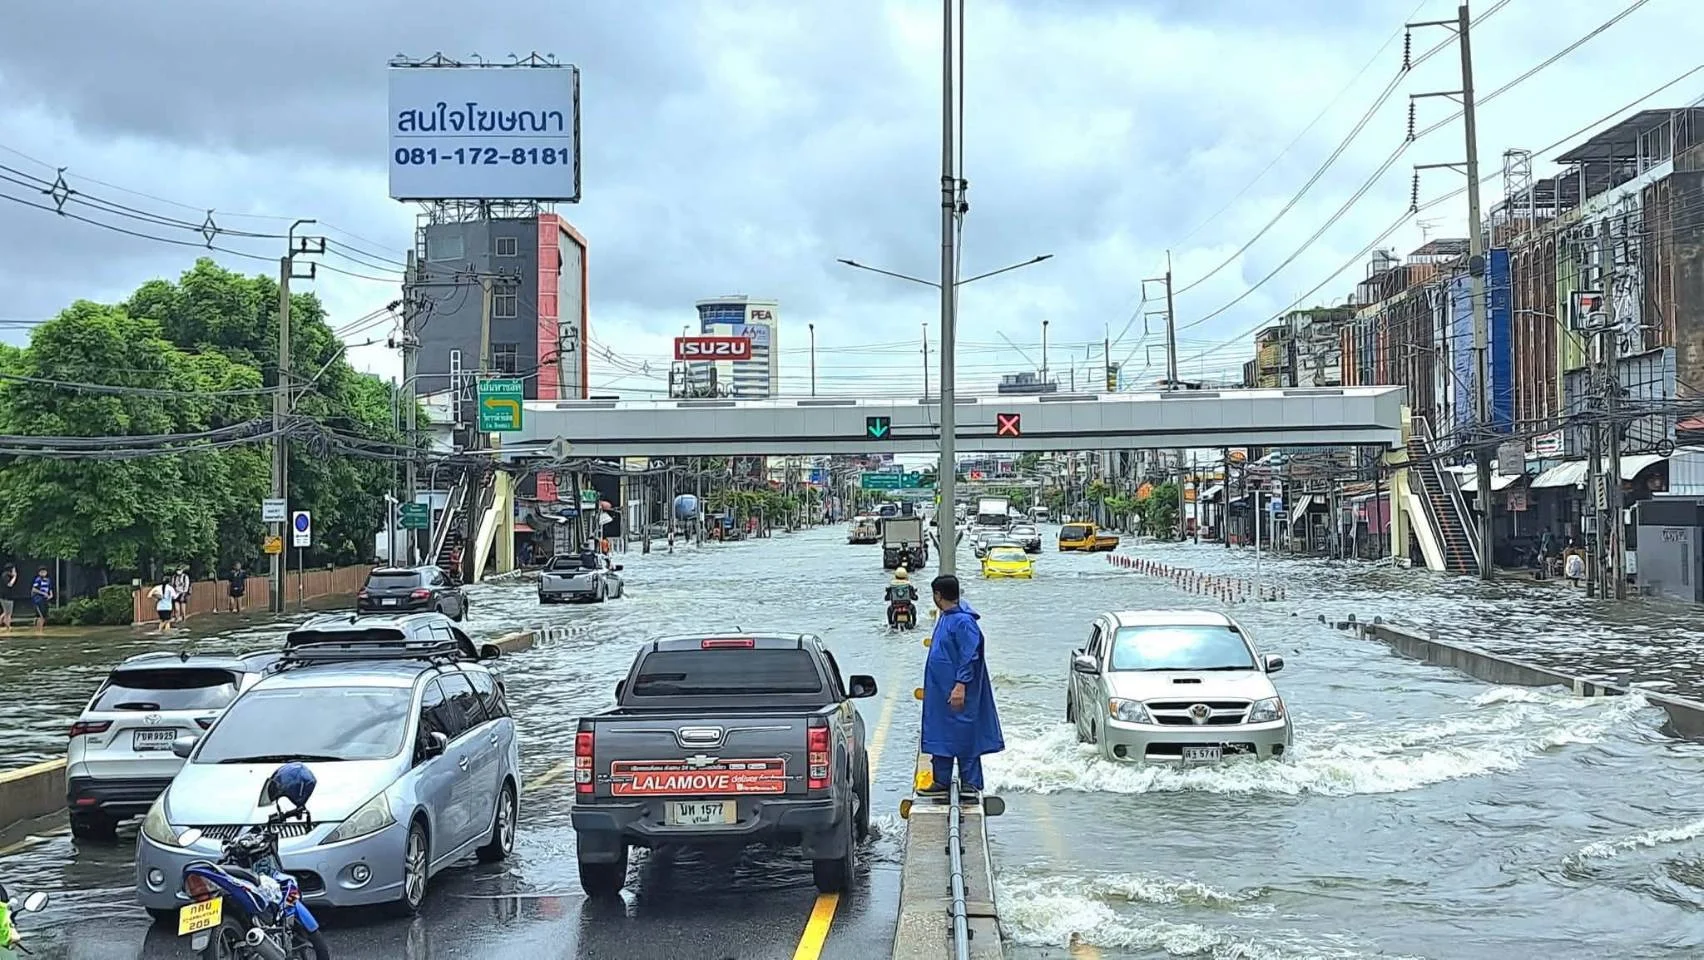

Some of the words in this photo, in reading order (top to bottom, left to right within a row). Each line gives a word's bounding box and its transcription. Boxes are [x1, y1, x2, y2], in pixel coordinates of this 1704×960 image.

[398, 101, 564, 132] สนใจโฆษณา
[394, 147, 569, 165] 081-172-8181
[751, 310, 772, 320] PEA
[680, 341, 745, 355] ISUZU
[632, 773, 729, 790] LALAMOVE
[701, 803, 724, 816] 1577
[189, 918, 210, 931] 205
